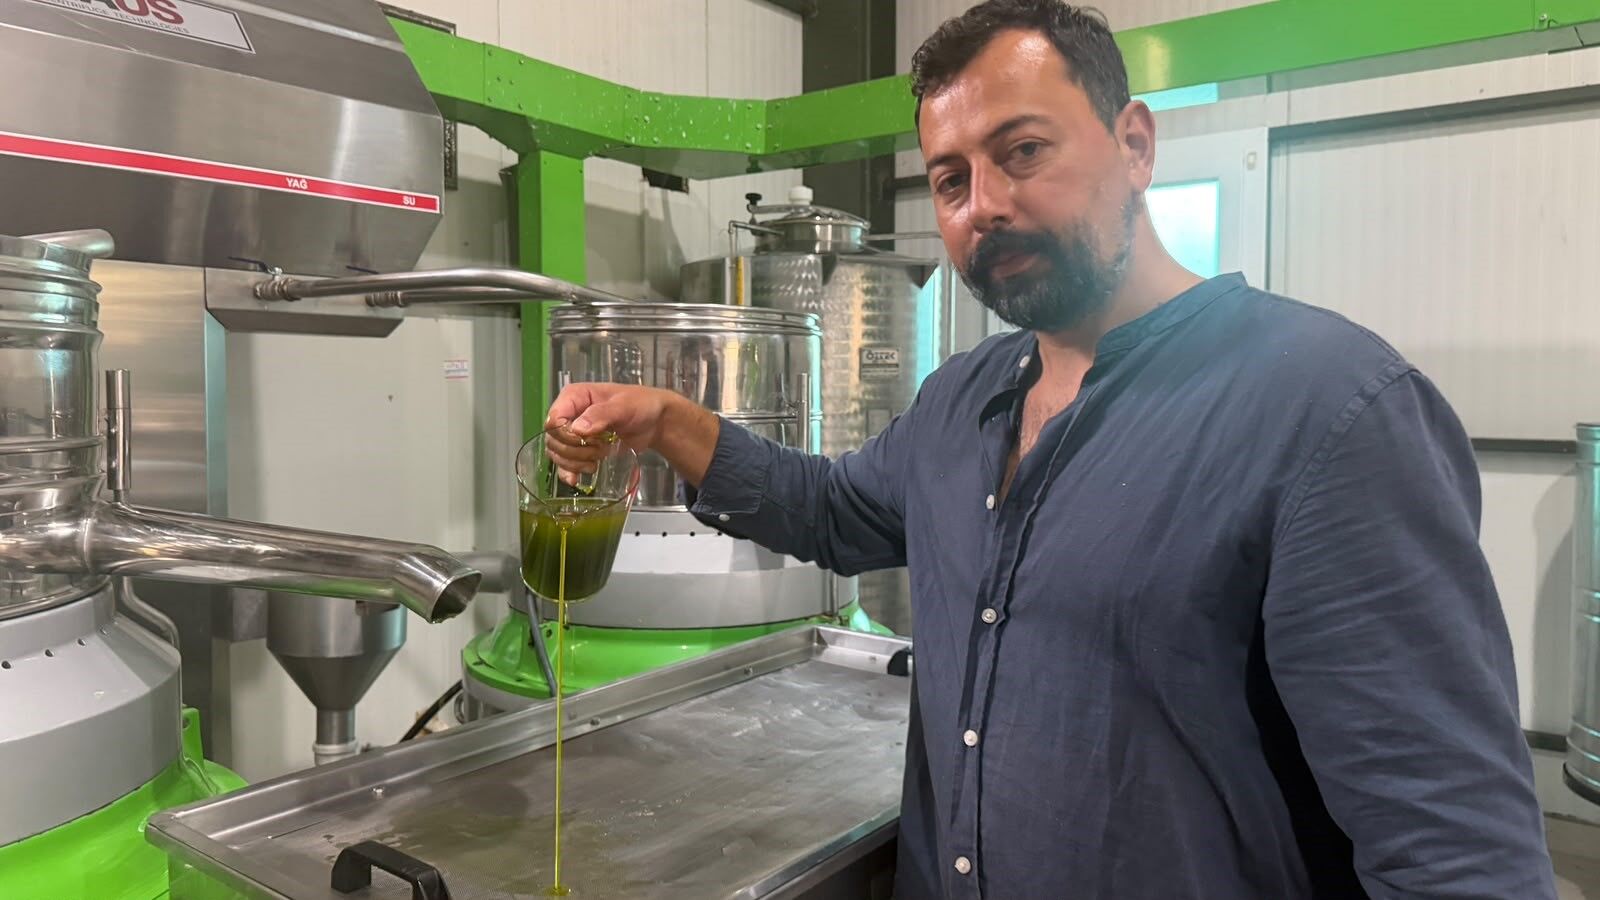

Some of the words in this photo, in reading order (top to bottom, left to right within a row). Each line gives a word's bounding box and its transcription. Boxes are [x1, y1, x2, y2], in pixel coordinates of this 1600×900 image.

[114, 11, 190, 33] TECHNOLOGIES
[286, 177, 308, 190] YAĞ
[403, 196, 416, 206] SU
